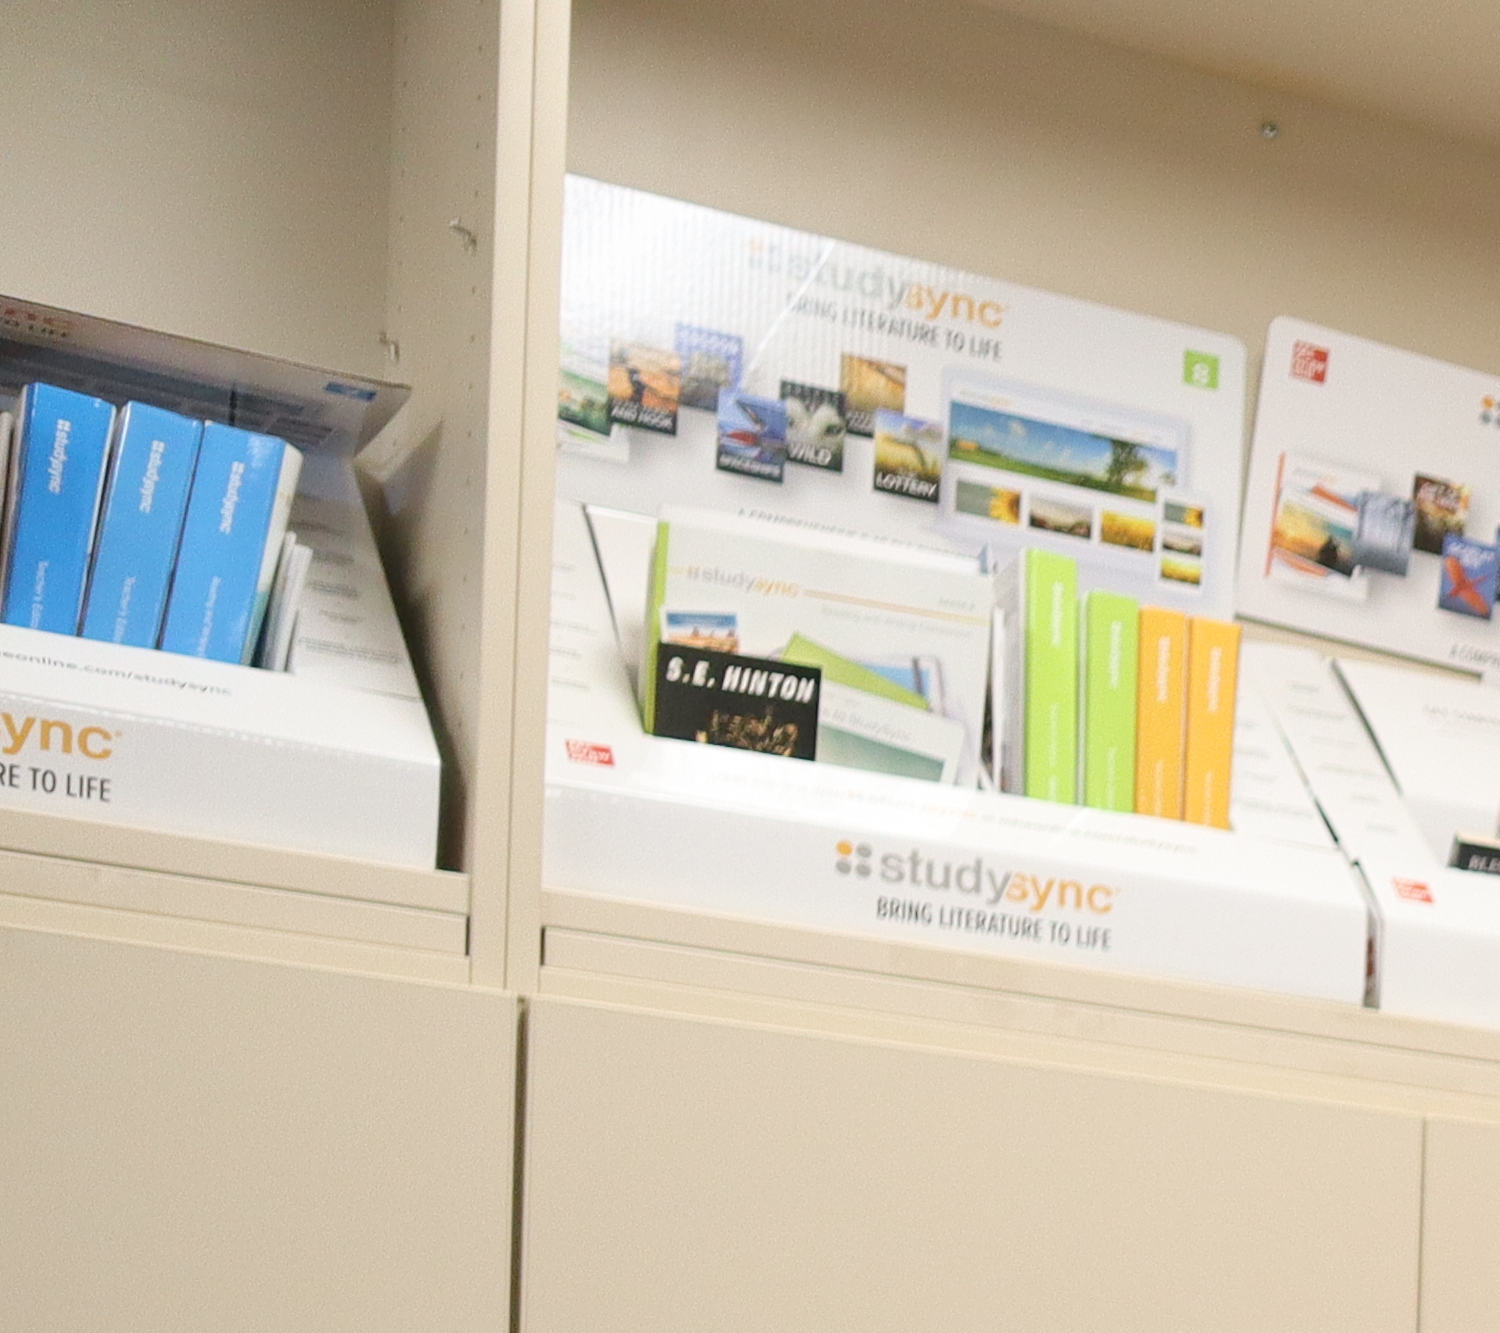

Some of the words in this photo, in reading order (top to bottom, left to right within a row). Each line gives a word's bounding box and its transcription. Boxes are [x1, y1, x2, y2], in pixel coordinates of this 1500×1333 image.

[841, 307, 939, 346] LITERATURE
[944, 329, 965, 351] TO
[969, 338, 1003, 360] LIFE
[0, 650, 233, 696] eonline.com/studysync
[664, 656, 715, 690] S.E.
[721, 664, 817, 705] HINTON
[0, 710, 114, 761] ync
[29, 766, 57, 794] TO
[65, 772, 112, 802] LIFE
[879, 846, 1116, 917] studysync
[876, 895, 933, 926] BRING
[939, 901, 1044, 943] LITERATURE
[1050, 920, 1071, 946] TO
[1075, 924, 1112, 952] LIFE
